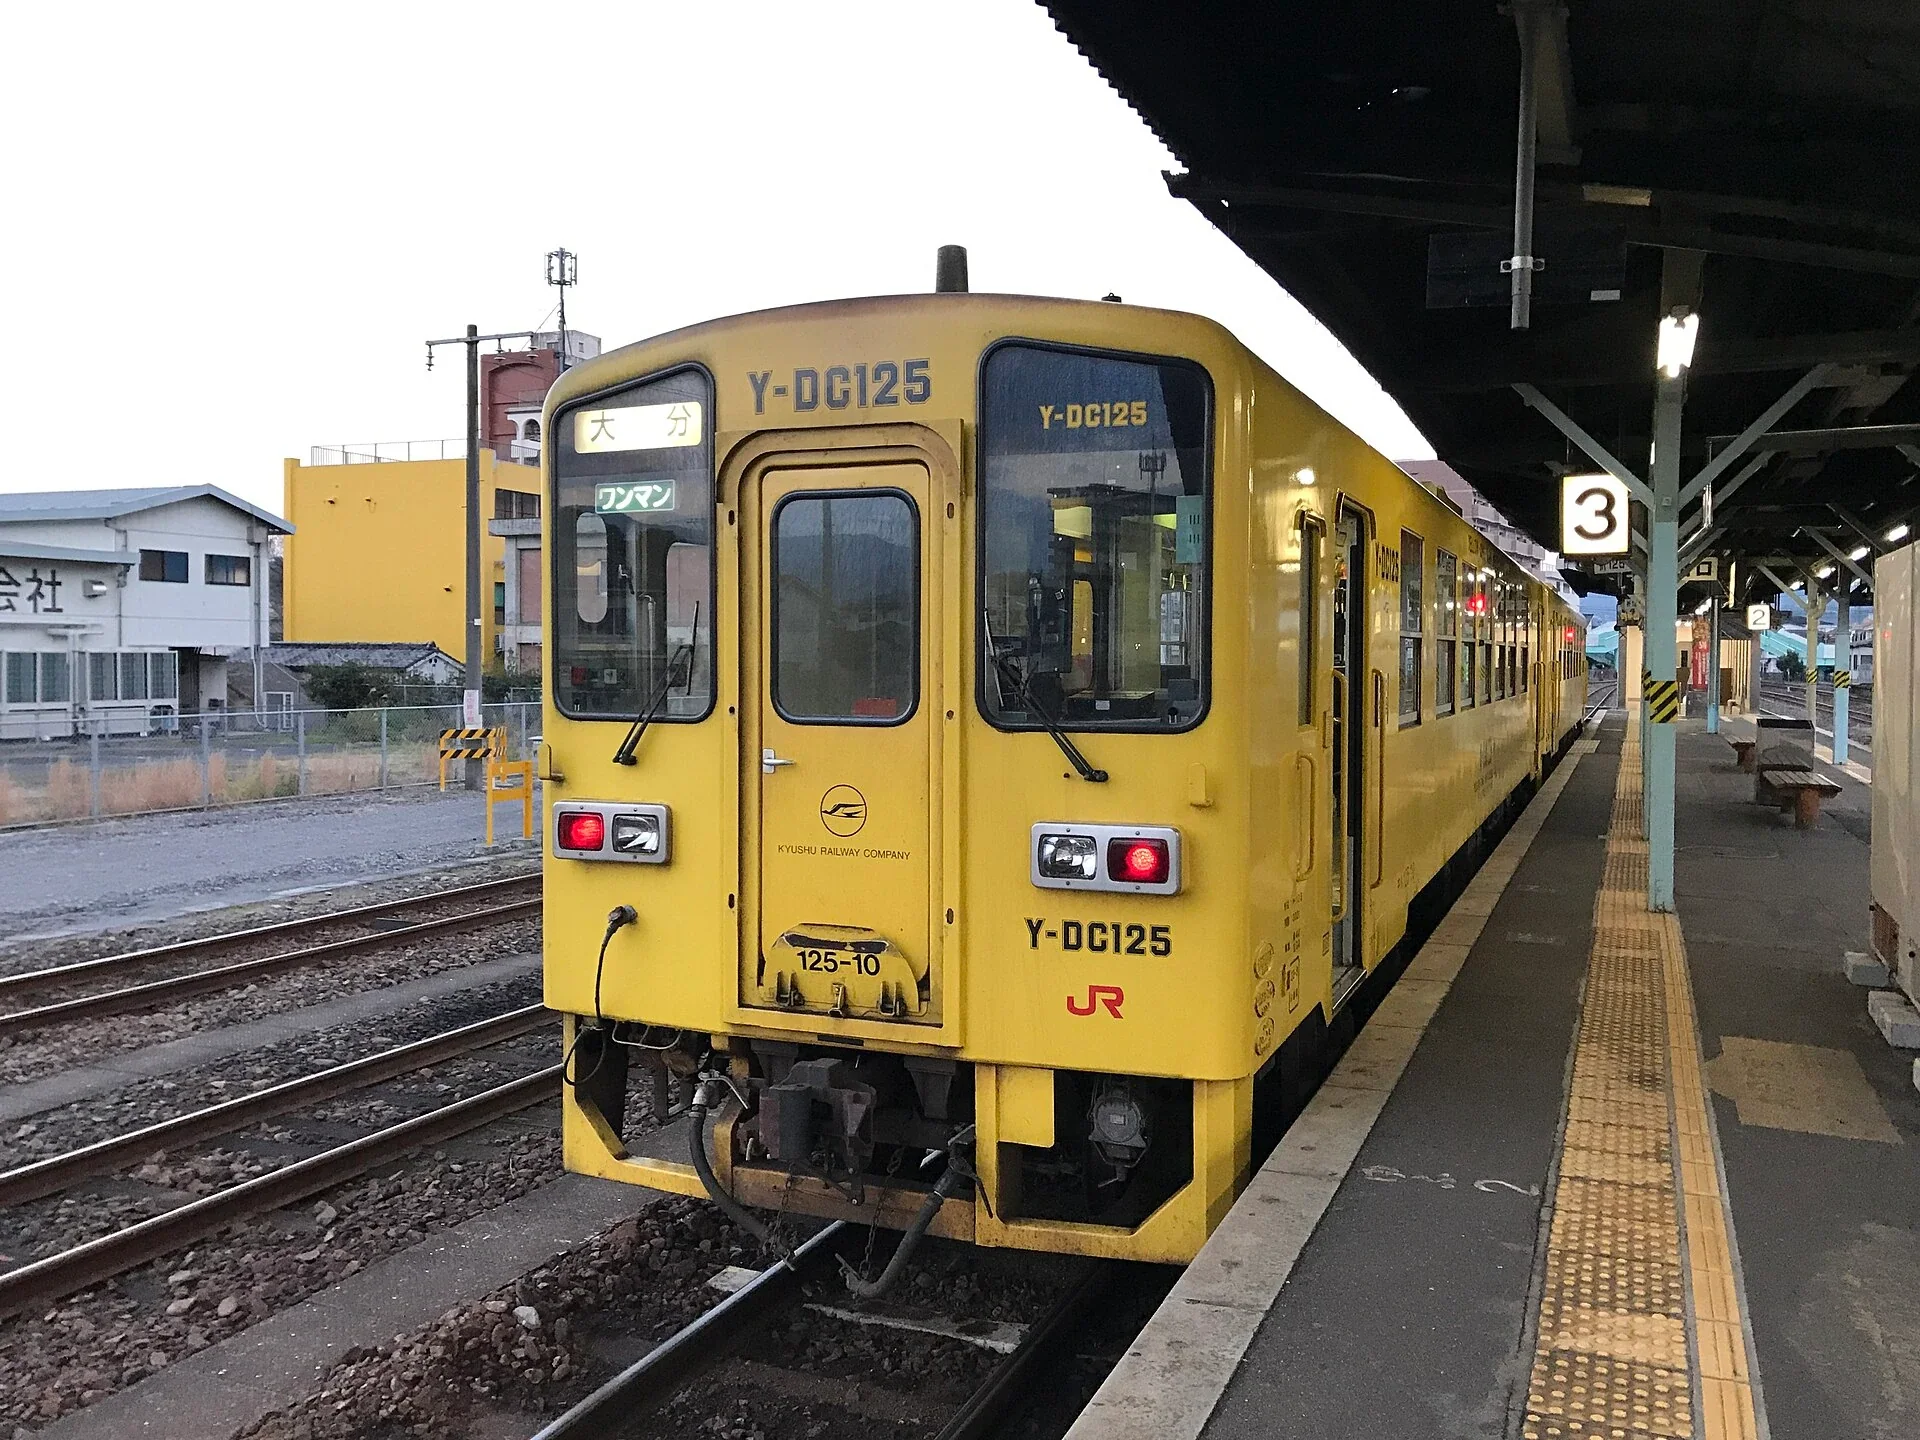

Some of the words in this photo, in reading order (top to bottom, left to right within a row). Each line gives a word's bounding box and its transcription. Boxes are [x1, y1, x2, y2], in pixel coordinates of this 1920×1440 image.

[747, 358, 932, 415] Y-DC125
[1039, 401, 1147, 430] Y-DC125
[599, 484, 672, 510] ワンマン
[1574, 487, 1617, 541] 3
[1752, 609, 1767, 626] 2
[778, 844, 817, 855] KYUSHU
[820, 847, 861, 857] RAILWAY
[863, 849, 911, 860] COMPANY
[1024, 917, 1172, 957] Y-DC125
[796, 949, 880, 976] 125-10
[1066, 984, 1124, 1019] JR
